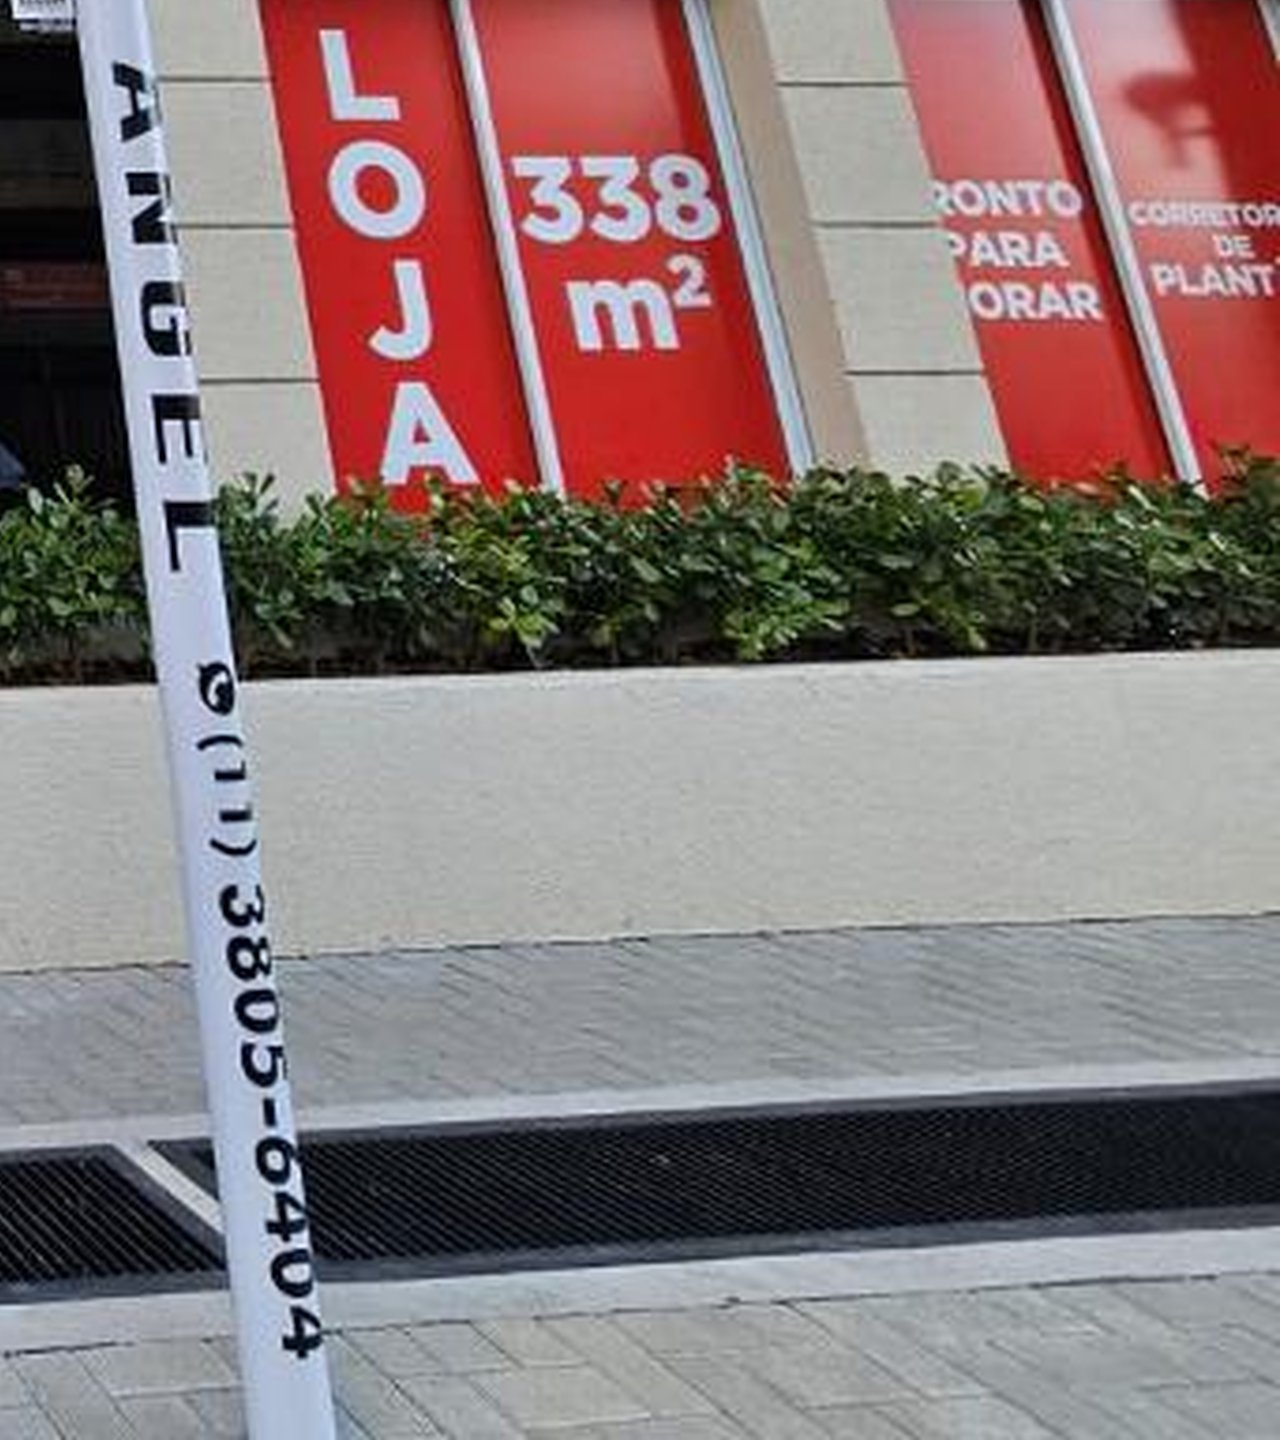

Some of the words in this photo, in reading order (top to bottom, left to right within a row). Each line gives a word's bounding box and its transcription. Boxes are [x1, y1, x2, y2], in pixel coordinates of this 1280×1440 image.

[510, 153, 721, 244] 338
[929, 179, 1083, 218] RONTO
[319, 29, 480, 485] LOJA
[1212, 234, 1255, 258] DE
[969, 283, 1104, 320] ORAR
[1151, 264, 1276, 296] PLANT
[112, 62, 215, 571] ANGEL
[219, 884, 323, 1360] 3805-6404
